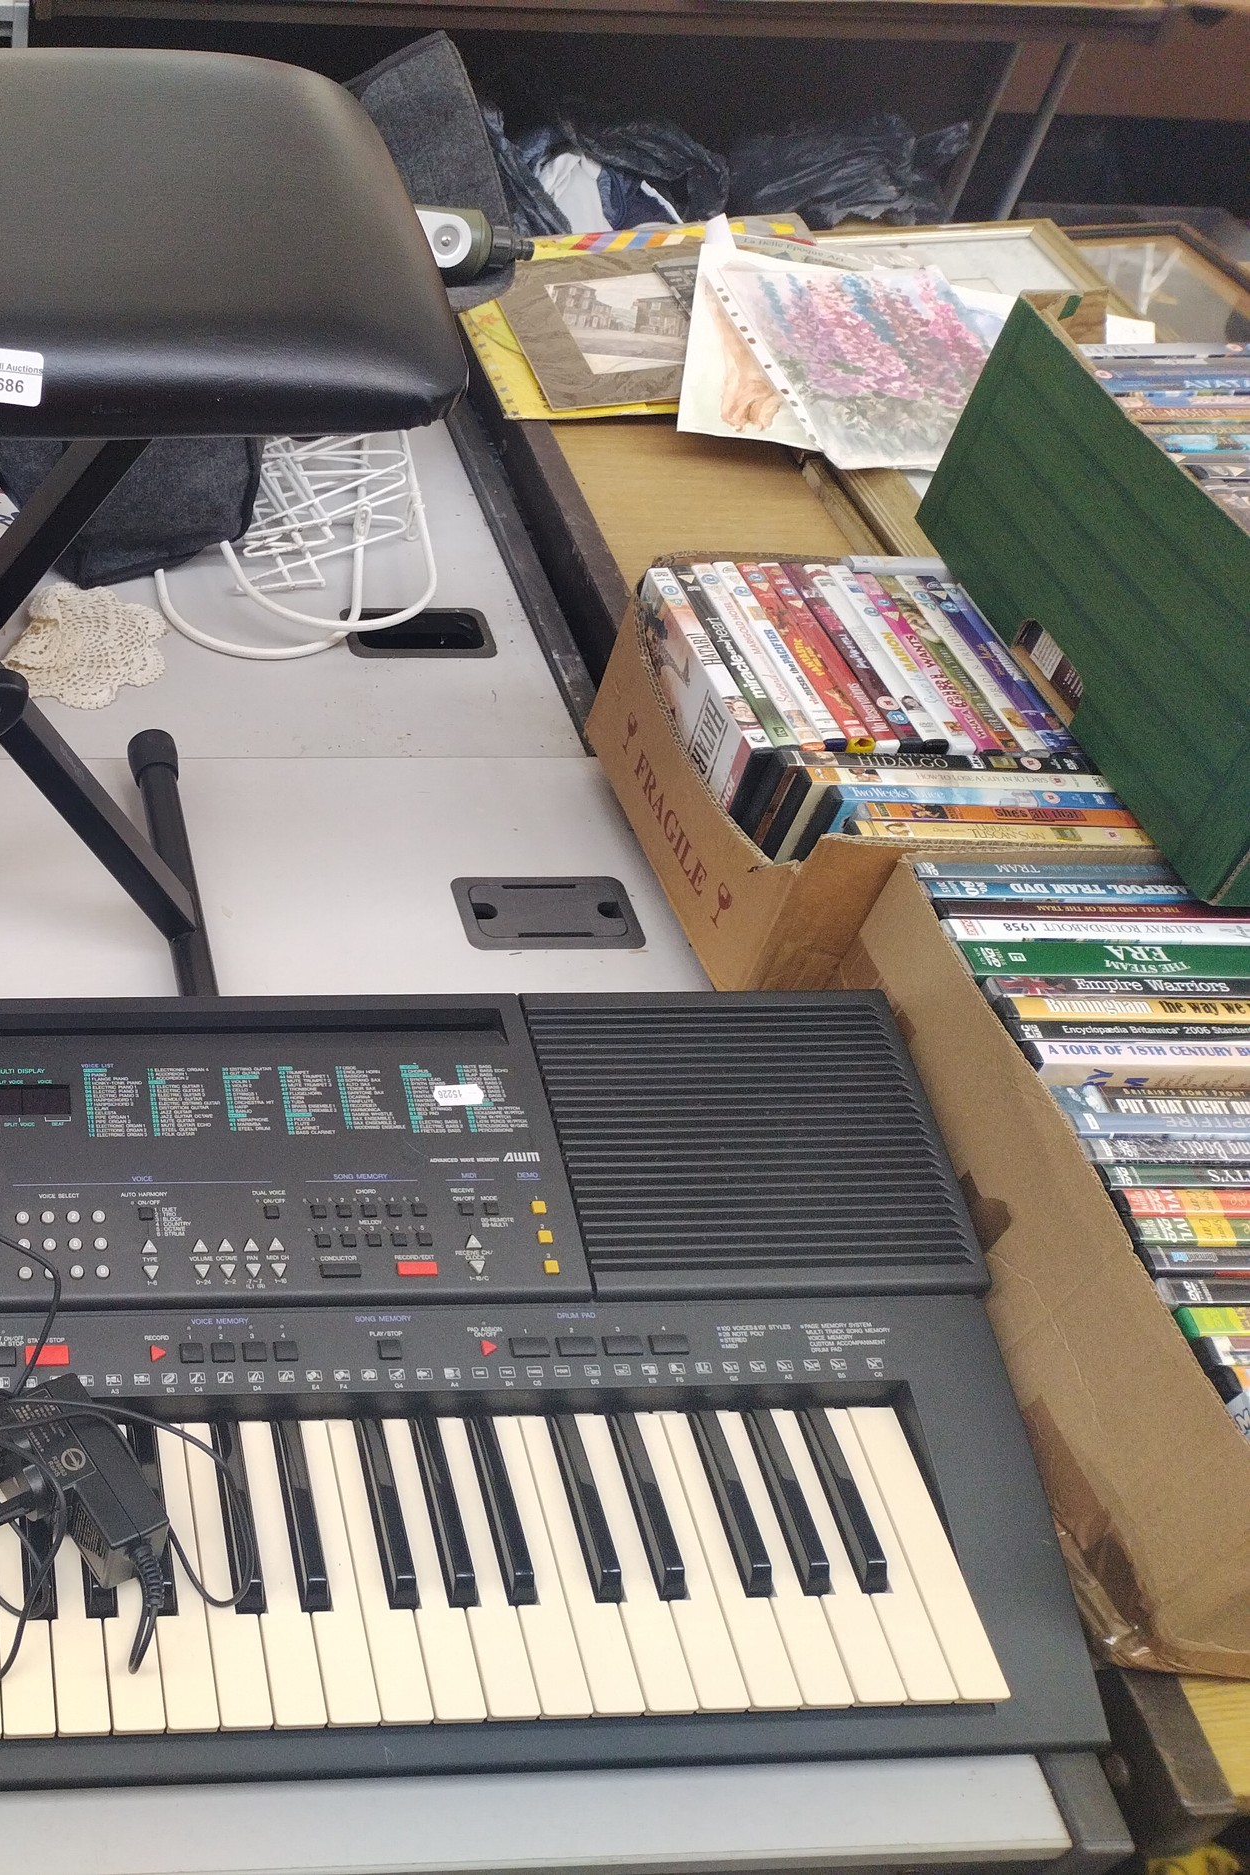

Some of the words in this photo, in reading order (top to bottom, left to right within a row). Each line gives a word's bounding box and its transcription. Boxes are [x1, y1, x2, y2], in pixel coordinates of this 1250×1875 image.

[6, 364, 43, 374] Auctions
[1182, 380, 1250, 389] AVATA
[686, 633, 724, 667] HATARI!
[763, 629, 795, 665] PACIFIER
[881, 631, 916, 673] MARION
[905, 634, 937, 669] WANTS
[730, 655, 768, 699] miracle
[691, 695, 726, 776] HATAR
[859, 755, 948, 768] HIDALGO
[872, 787, 910, 799] Weeks
[635, 750, 707, 896] FRAGILE
[995, 864, 1040, 874] TRAM
[1010, 882, 1049, 894] DVD
[1052, 882, 1106, 894] TRAM
[1113, 882, 1188, 895] ACKPOOL
[1003, 921, 1036, 932] 1958
[1043, 923, 1142, 933] ROUNDABOUT
[1145, 925, 1204, 933] RAILWAY
[1103, 945, 1172, 963] ERA
[1105, 959, 1159, 974] STEAM
[1160, 960, 1191, 972] THE
[1072, 978, 1143, 993] Empire
[1149, 979, 1231, 993] Warriors
[1044, 998, 1153, 1015] Birmingham
[1159, 1000, 1187, 1013] the
[1189, 1002, 1219, 1016] way
[1220, 1002, 1246, 1014] we
[1020, 1024, 1030, 1038] PC
[1182, 1026, 1211, 1034] 2006
[1048, 1045, 1059, 1055] A
[1061, 1045, 1103, 1055] TOUR
[1103, 1045, 1123, 1055] OF
[1127, 1045, 1166, 1056] 18TH
[1170, 1046, 1234, 1057] CENTURY
[1115, 1099, 1148, 1113] PUT
[1148, 1099, 1186, 1114] THAT
[1186, 1100, 1230, 1114] LIGHT
[1230, 1101, 1250, 1114] OU
[503, 1152, 541, 1162] AWM
[355, 1315, 376, 1323] SONG
[378, 1314, 412, 1323] MEMORY
[556, 1311, 578, 1320] DRUM
[580, 1310, 597, 1320] PAD
[191, 1318, 213, 1326] VOICE
[216, 1317, 249, 1325] MEMORY
[144, 1334, 170, 1342] RECORD
[369, 1330, 403, 1338] PLAY/STOP
